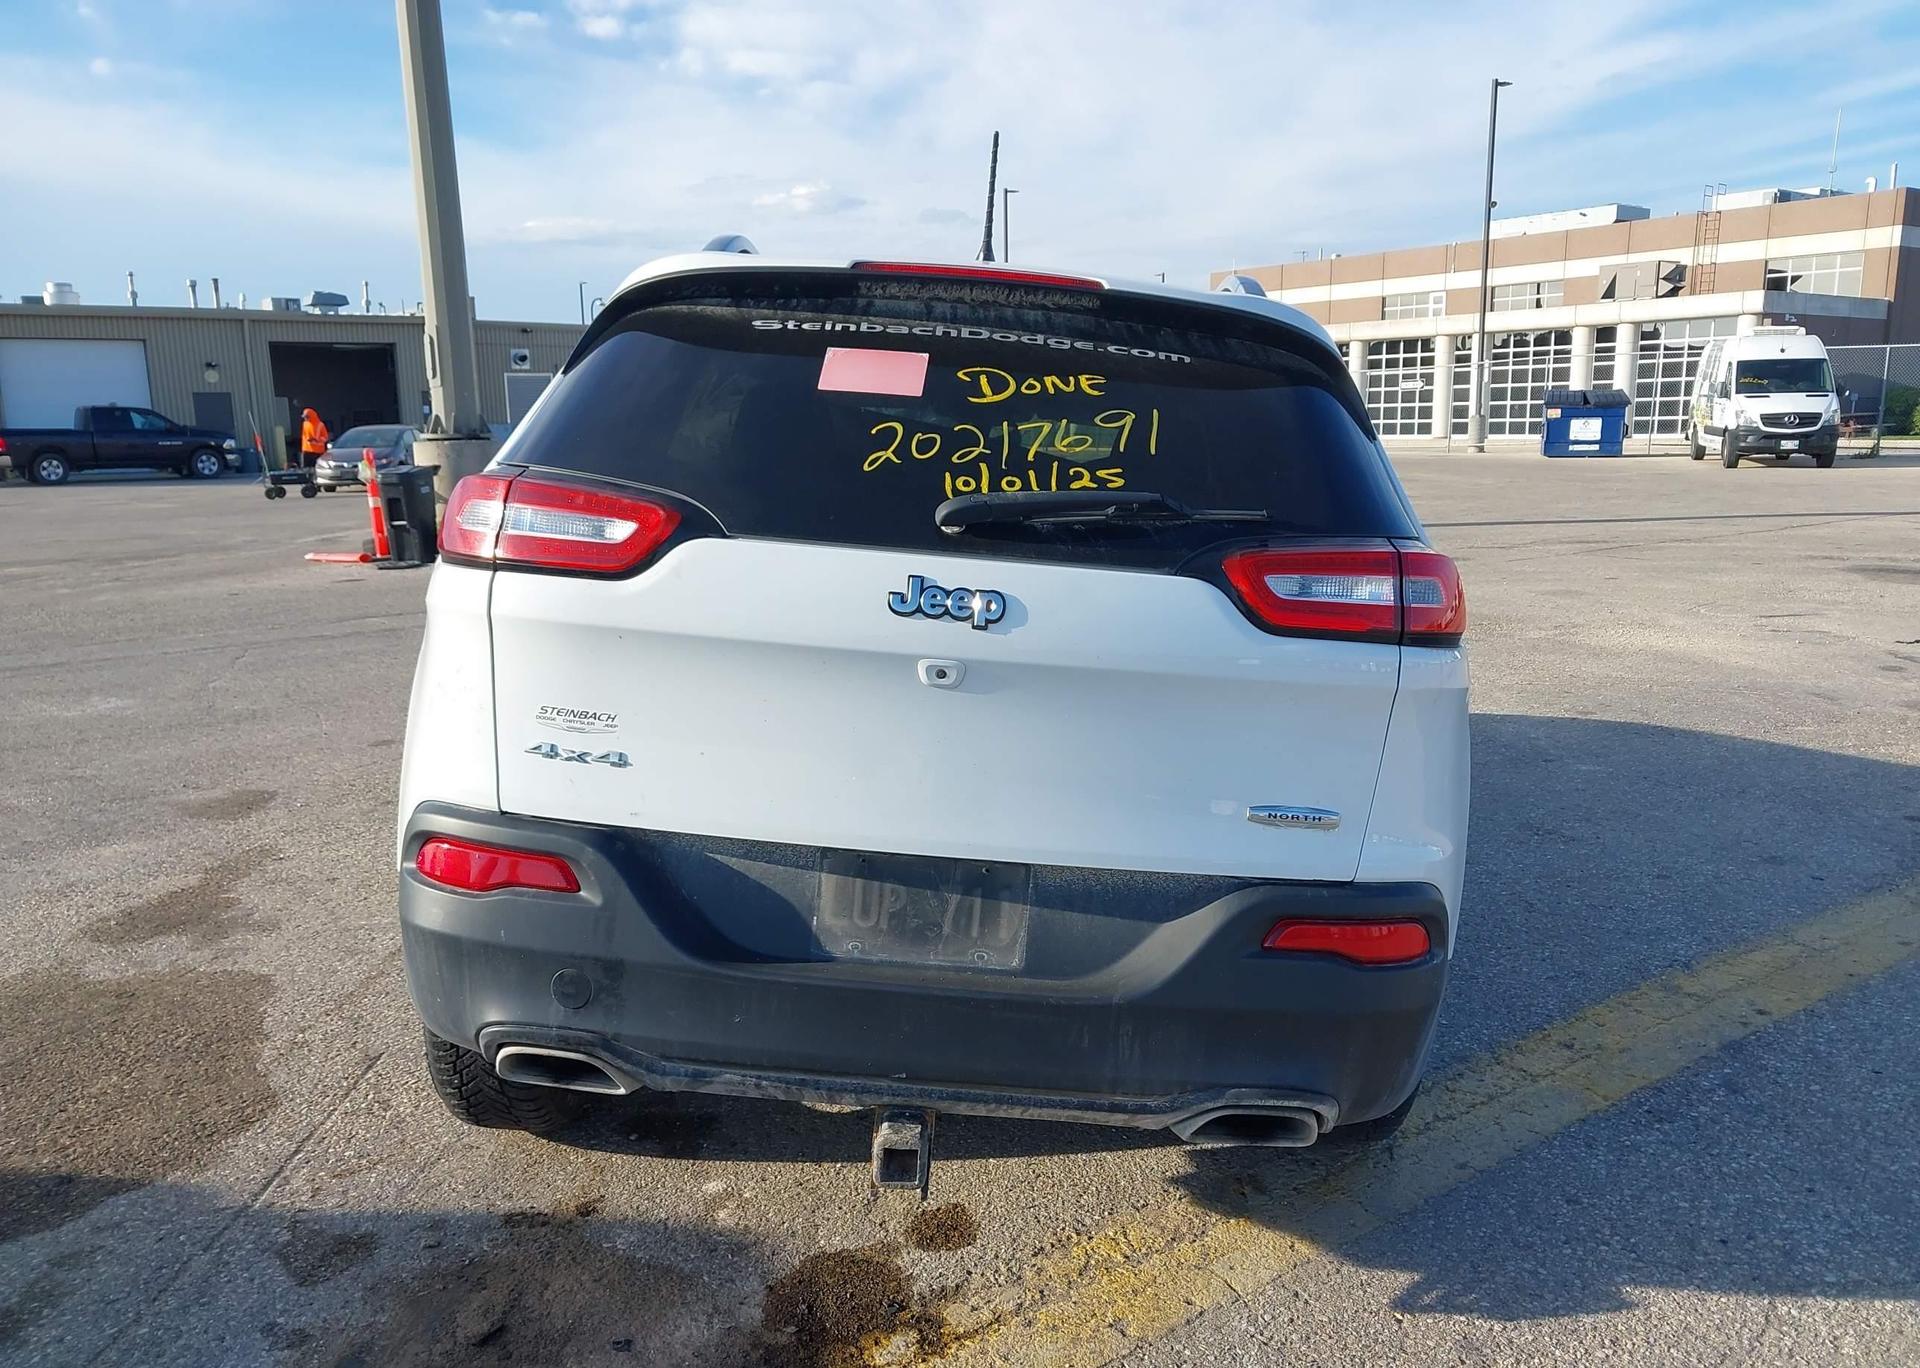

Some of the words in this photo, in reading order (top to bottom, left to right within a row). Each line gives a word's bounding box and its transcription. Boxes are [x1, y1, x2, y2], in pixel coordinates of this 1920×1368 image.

[751, 319, 1191, 364] SteinbachDodge.com
[863, 409, 1158, 471] 20217691
[945, 462, 1126, 498] 10/01/25
[887, 574, 1006, 630] Jeep
[538, 706, 617, 722] STEINBACH
[524, 741, 634, 769] 4x4
[1267, 812, 1322, 822] NORTH
